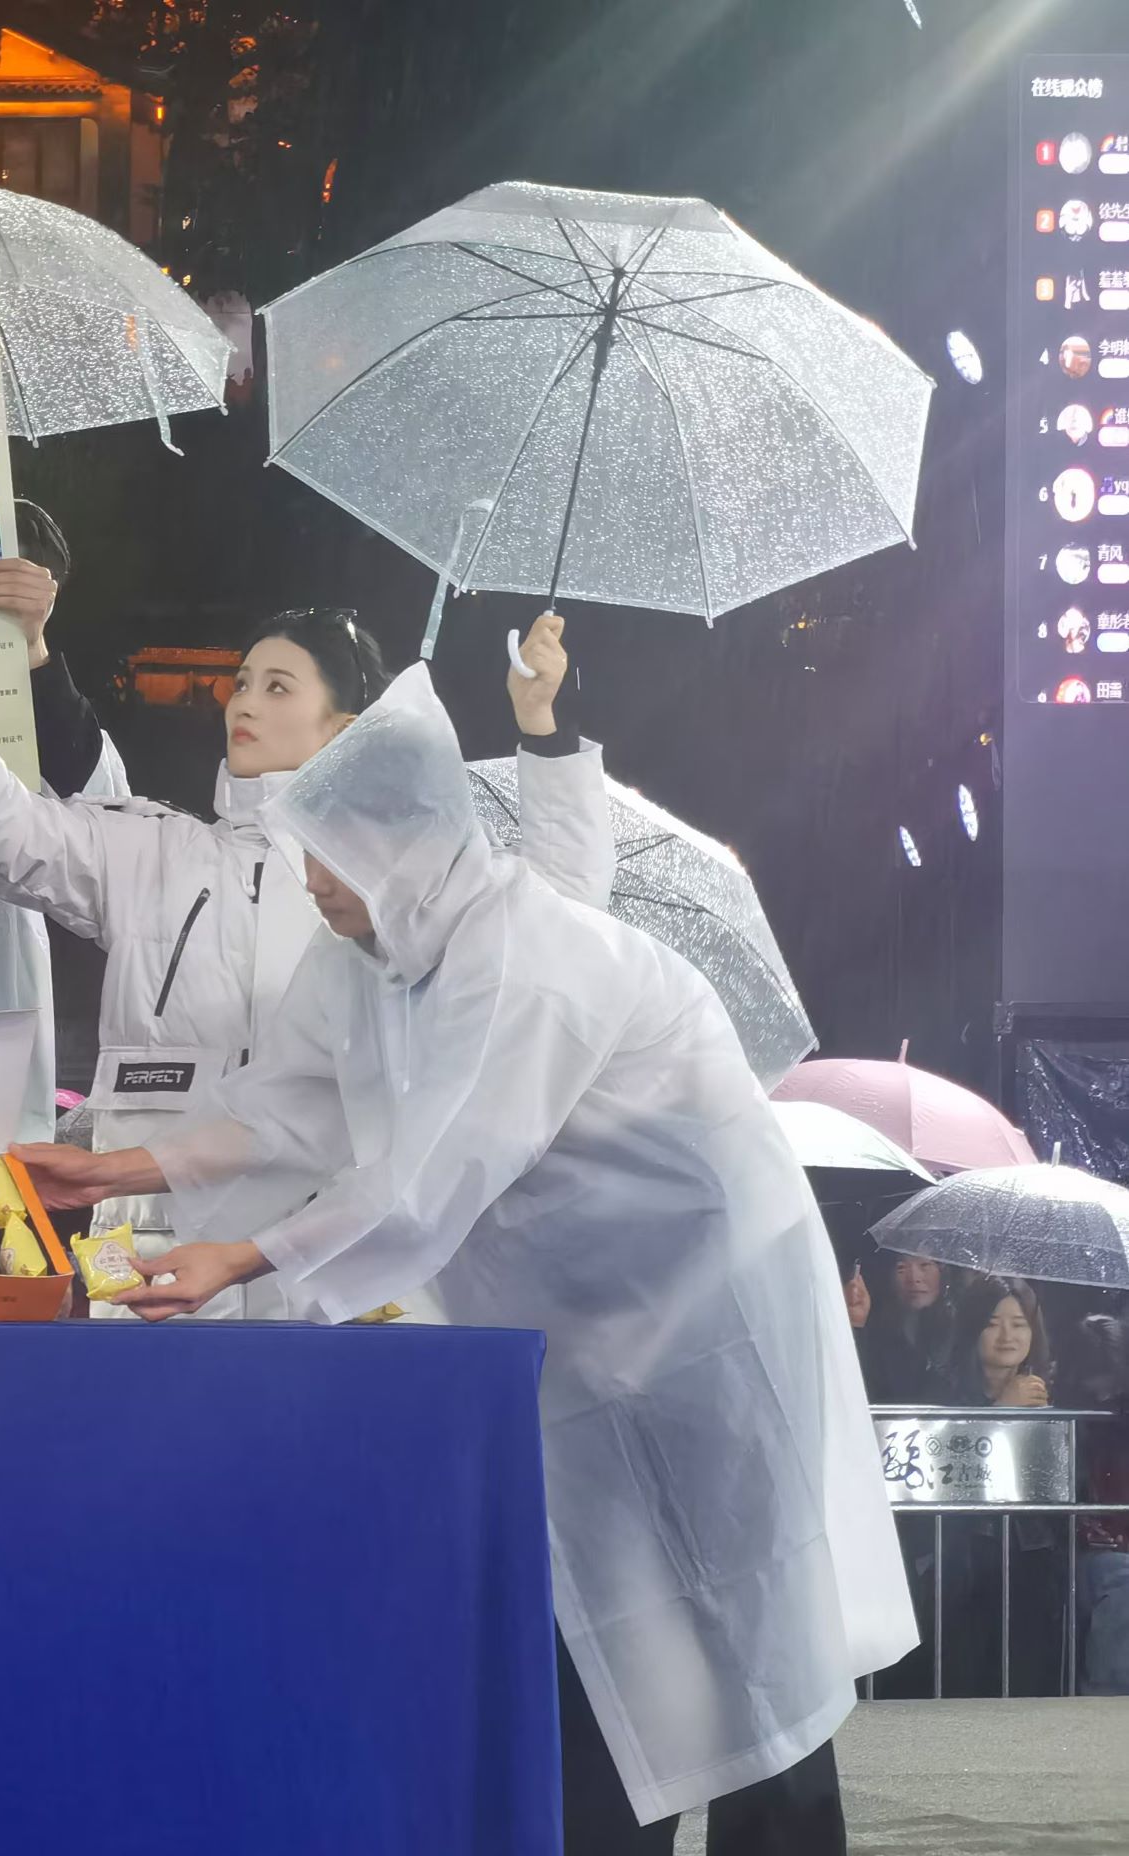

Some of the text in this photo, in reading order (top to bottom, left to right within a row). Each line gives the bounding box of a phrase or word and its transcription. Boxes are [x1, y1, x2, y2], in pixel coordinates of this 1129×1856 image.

[1039, 348, 1050, 365] 4
[1039, 417, 1049, 434] 5
[1039, 488, 1049, 502] 6
[1038, 556, 1048, 571] 7
[123, 1070, 185, 1085] PERFECT
